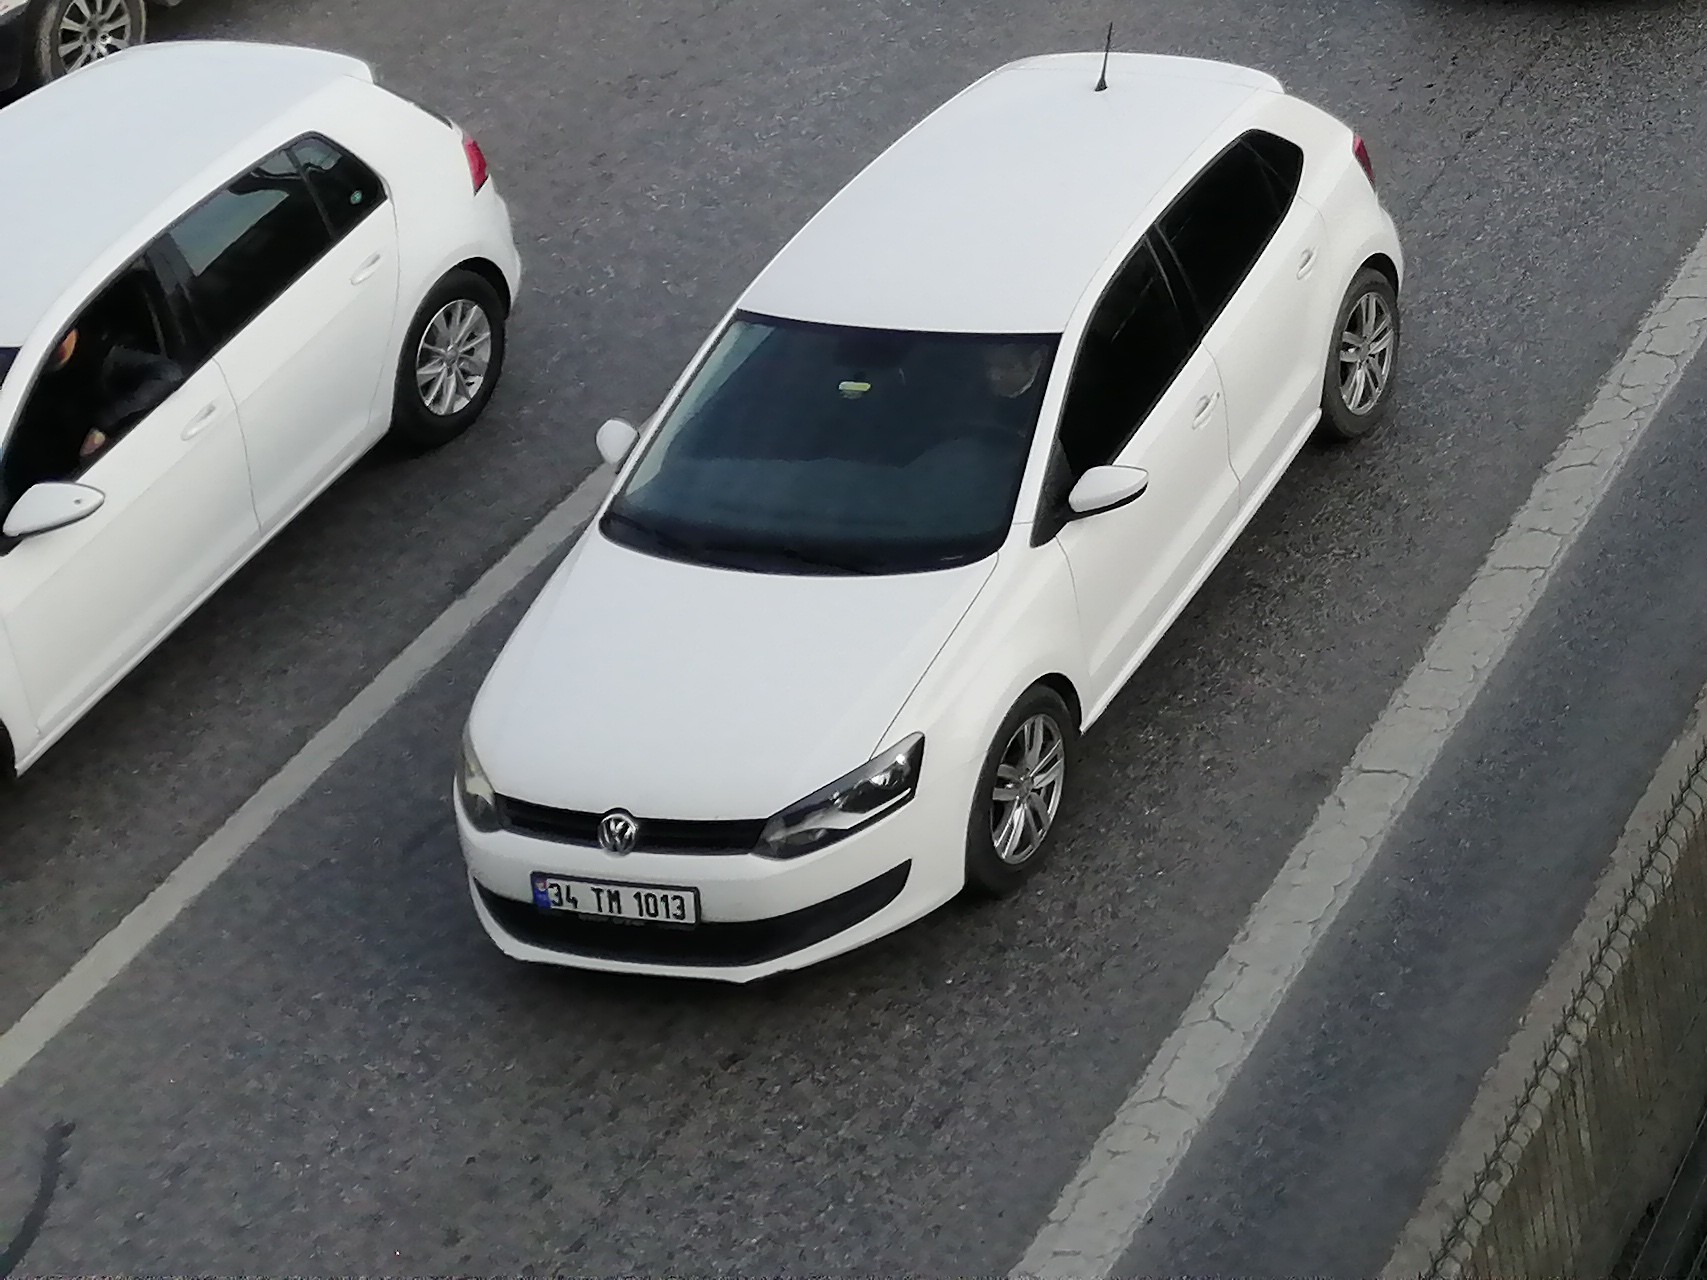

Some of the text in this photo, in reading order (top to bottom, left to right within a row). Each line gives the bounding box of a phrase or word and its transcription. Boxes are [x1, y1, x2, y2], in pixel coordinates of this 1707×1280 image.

[551, 882, 688, 921] 34 TM 1013
